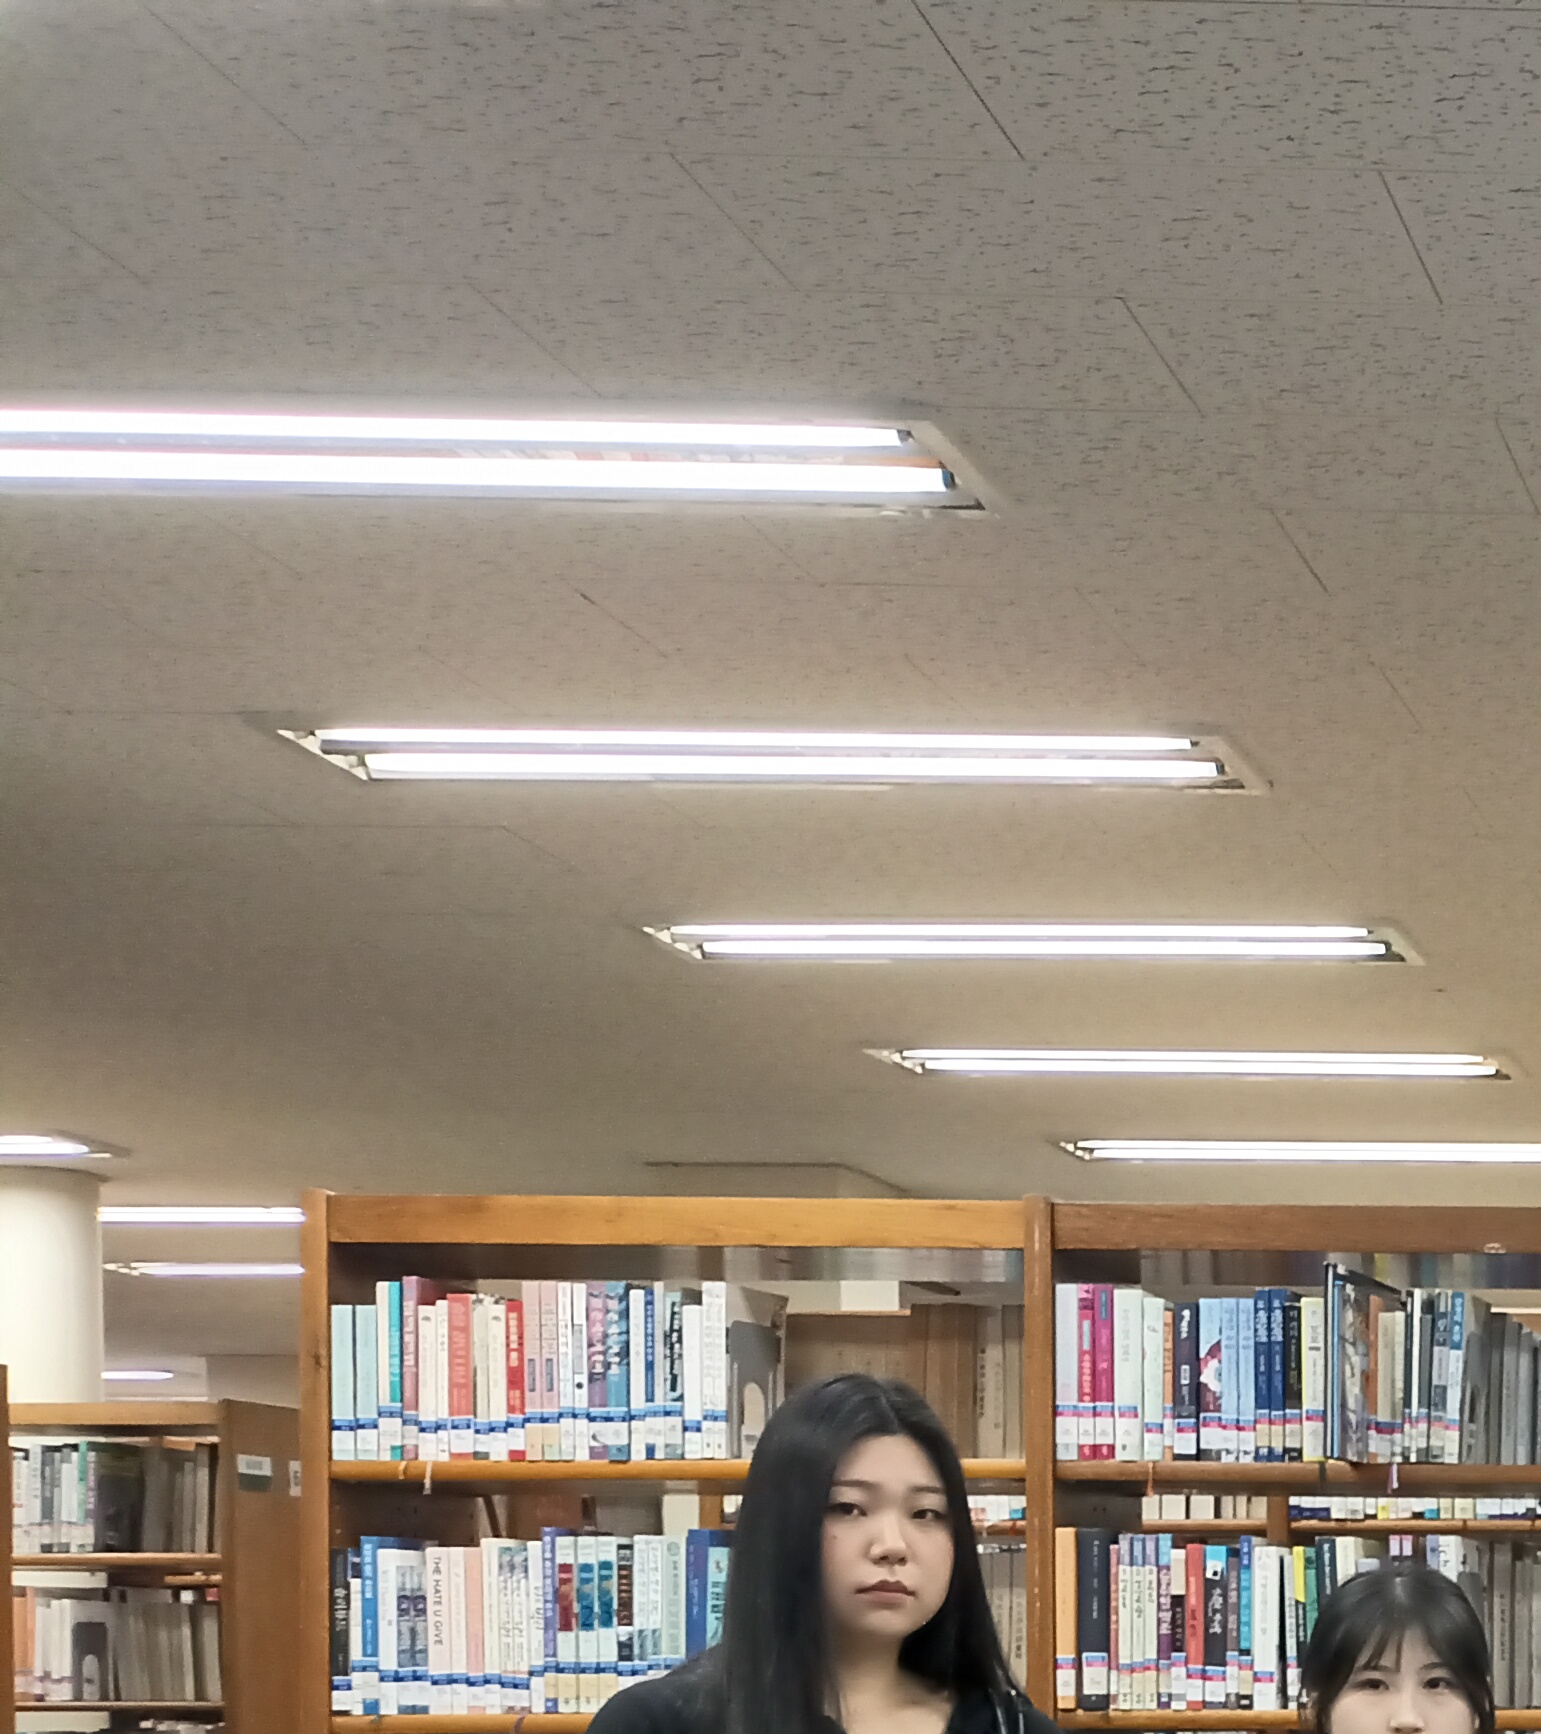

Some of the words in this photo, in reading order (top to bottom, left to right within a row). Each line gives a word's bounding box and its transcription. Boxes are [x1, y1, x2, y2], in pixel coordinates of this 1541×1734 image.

[433, 1556, 442, 1576] THE
[433, 1578, 443, 1606] HATE
[433, 1609, 443, 1618] U
[433, 1620, 444, 1646] GIVE
